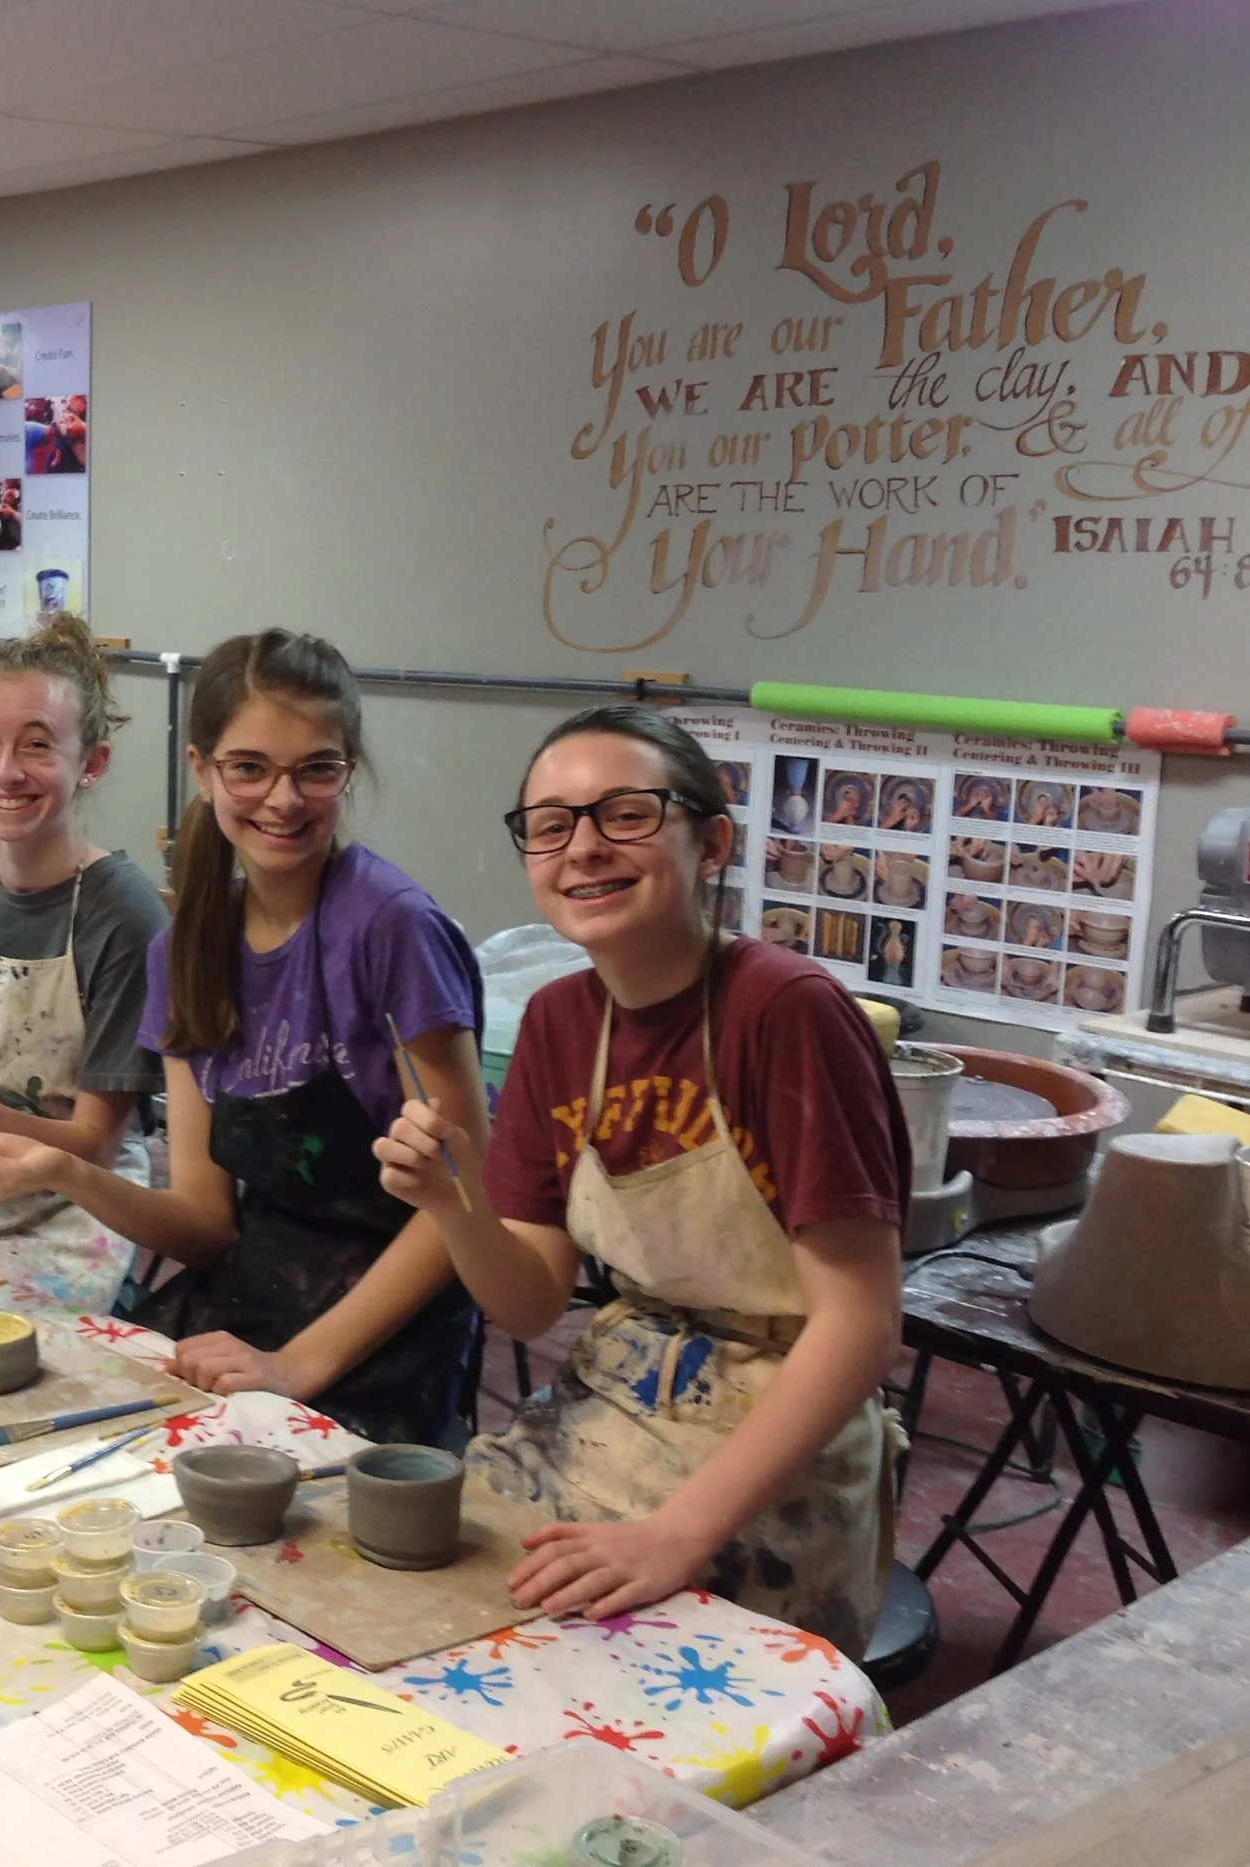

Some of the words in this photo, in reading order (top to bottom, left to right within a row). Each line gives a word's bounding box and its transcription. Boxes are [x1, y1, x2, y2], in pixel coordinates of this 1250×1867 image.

[775, 160, 954, 300] Lord,
[580, 309, 667, 445] You
[686, 321, 743, 362] are
[770, 313, 844, 355] our
[873, 199, 1169, 369] Father,
[636, 378, 710, 421] WE
[737, 366, 839, 412] ARE
[878, 351, 950, 410] the
[1108, 350, 1250, 397] AND
[707, 431, 772, 469] our
[1015, 400, 1088, 457] &
[1113, 396, 1184, 450] all
[27, 509, 48, 520] Create
[646, 483, 722, 518] ARE
[730, 480, 809, 514] THE
[828, 475, 939, 515] WORK
[959, 474, 1020, 509] OF
[1052, 514, 1236, 554] ISAIAH
[1169, 553, 1250, 601] 64:8
[769, 733, 830, 749] Centering
[835, 739, 845, 749] &
[850, 739, 911, 756] Throwing
[916, 745, 929, 756] II
[845, 723, 916, 742] Throwing
[1039, 738, 1121, 759] Throwing
[953, 748, 1023, 766] Centering
[1026, 753, 1039, 766] &
[1044, 755, 1116, 773] Throwing
[1121, 761, 1141, 774] III
